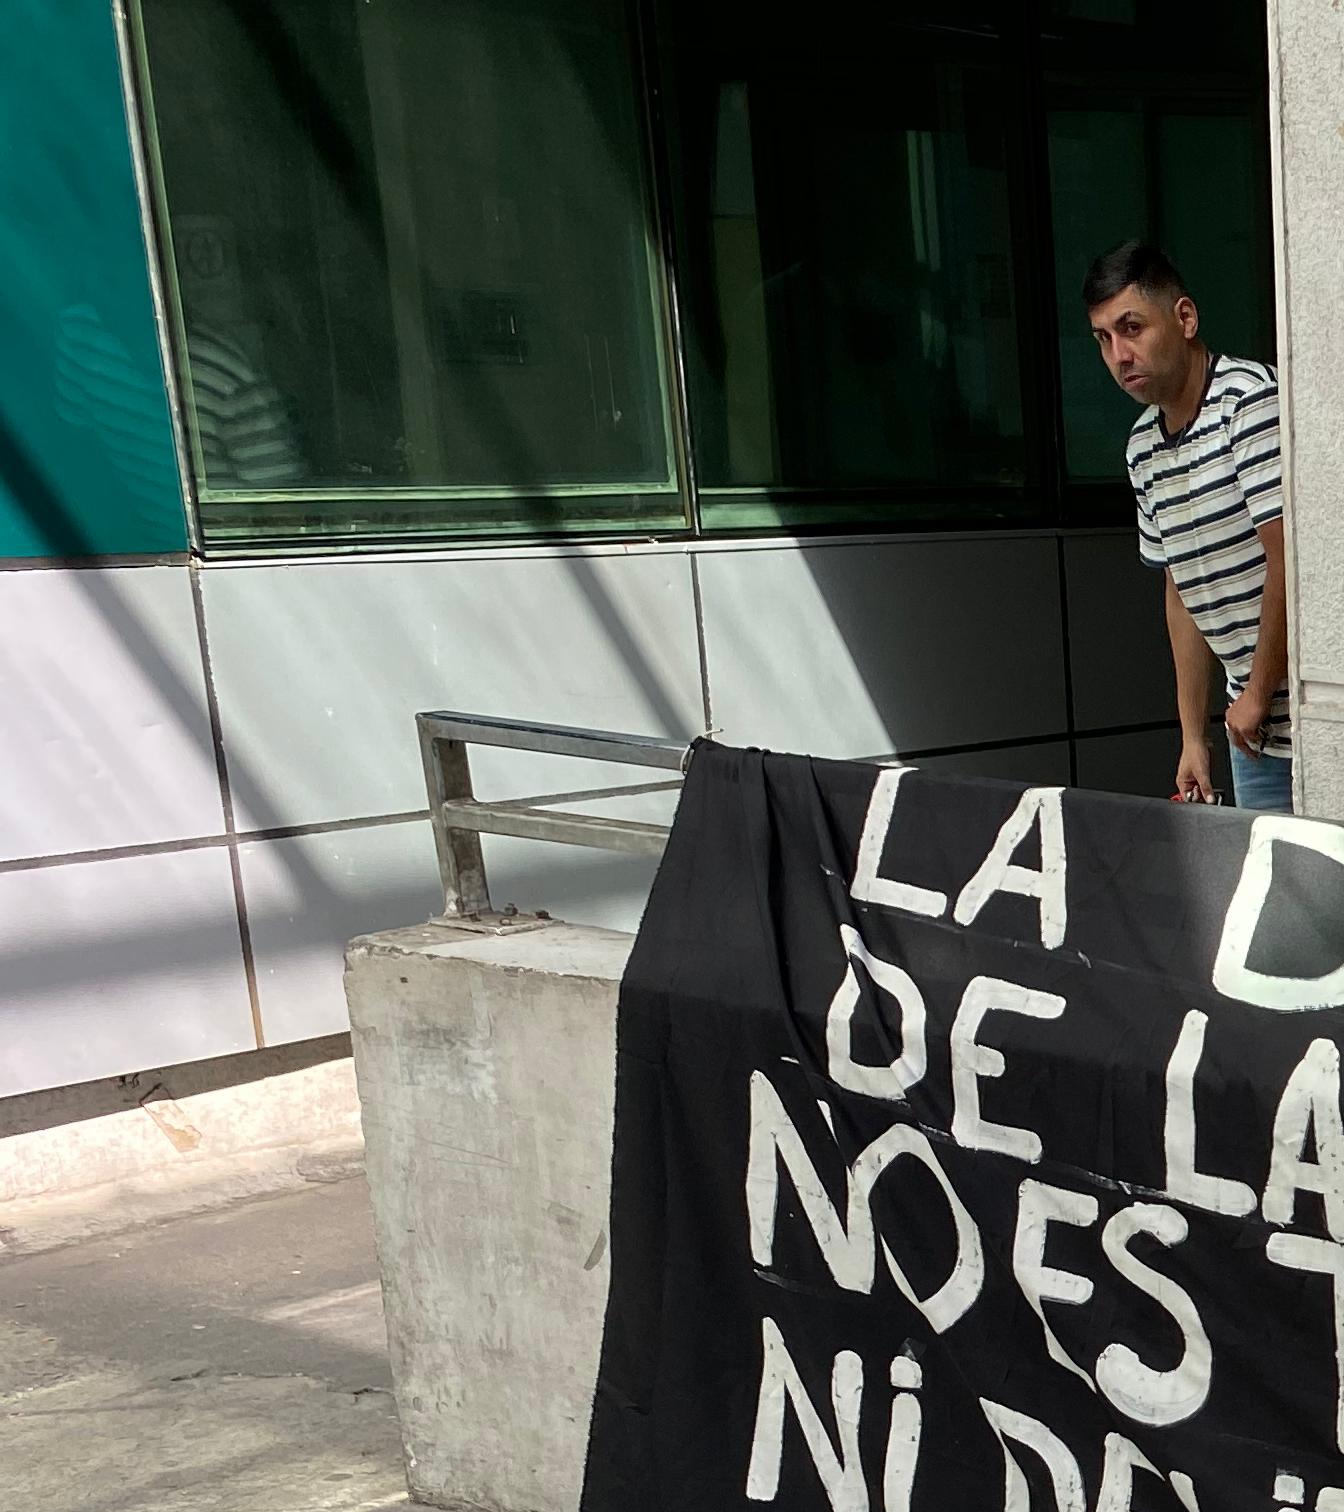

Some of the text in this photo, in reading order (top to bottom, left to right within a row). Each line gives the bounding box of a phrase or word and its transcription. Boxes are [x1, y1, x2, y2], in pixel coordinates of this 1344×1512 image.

[850, 765, 1067, 950] LA
[826, 924, 1067, 1164] DE
[746, 1070, 985, 1334] NO
[1013, 1179, 1213, 1427] ES
